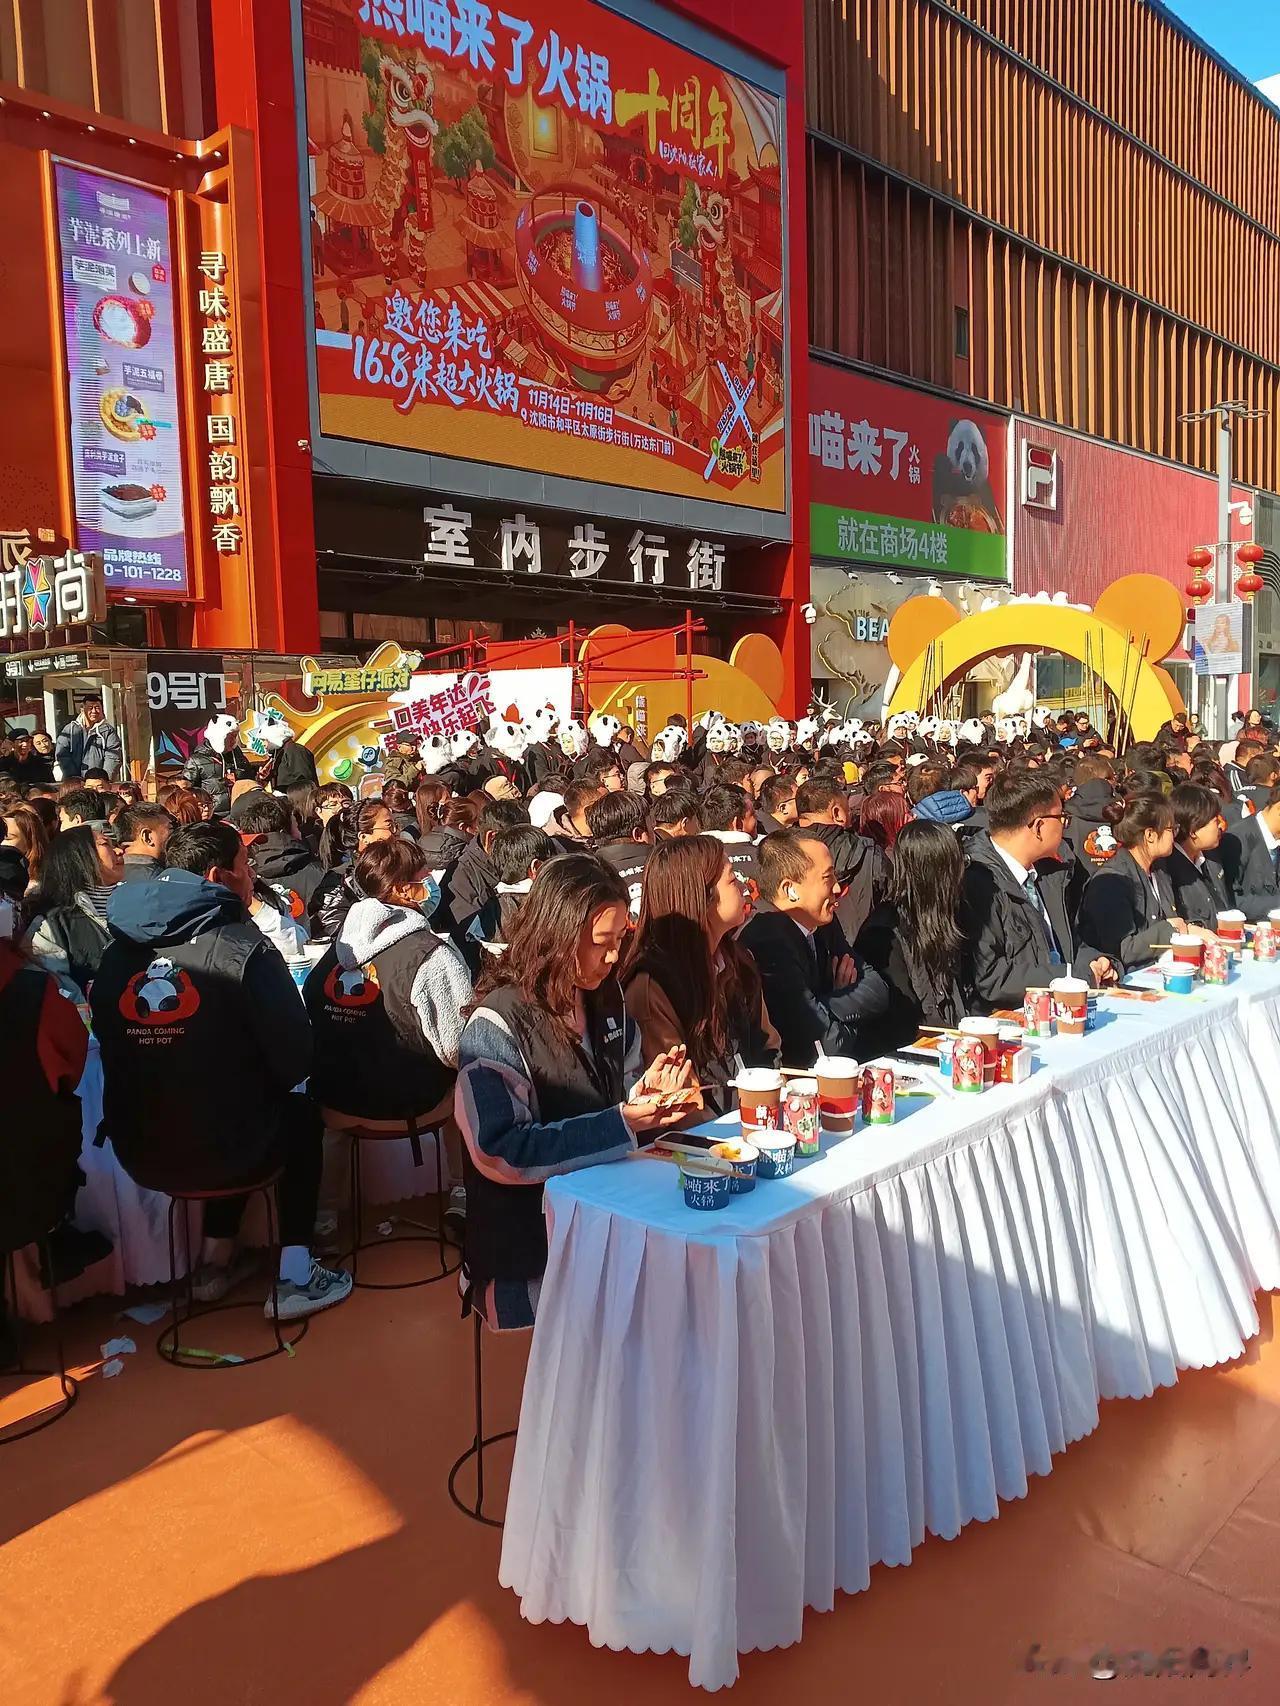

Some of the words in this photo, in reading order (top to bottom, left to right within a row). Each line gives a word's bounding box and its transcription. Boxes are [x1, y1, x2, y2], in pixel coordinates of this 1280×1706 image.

[615, 68, 731, 179] 十周年
[198, 251, 231, 391] 寻味盛唐
[384, 288, 492, 359] 邀您来吃
[352, 335, 520, 413] 16.8米超大火锅
[528, 389, 613, 425] 11月14日-11月16日
[529, 410, 675, 456] 沈阳市和平区太原街步行街(万达东门前)
[808, 410, 908, 480] 喵来了
[908, 445, 920, 484] 火锅
[207, 414, 241, 552] 国韵飘香
[103, 549, 161, 565] 品牌热线
[424, 504, 726, 591] 室内步行街
[837, 515, 948, 565] 就在商场4楼
[147, 671, 227, 710] 9号门
[311, 668, 411, 692] 网易蛋仔派对
[373, 683, 469, 729] 一口美年达
[154, 1027, 185, 1035] COMING
[690, 1195, 715, 1207] 火锅
